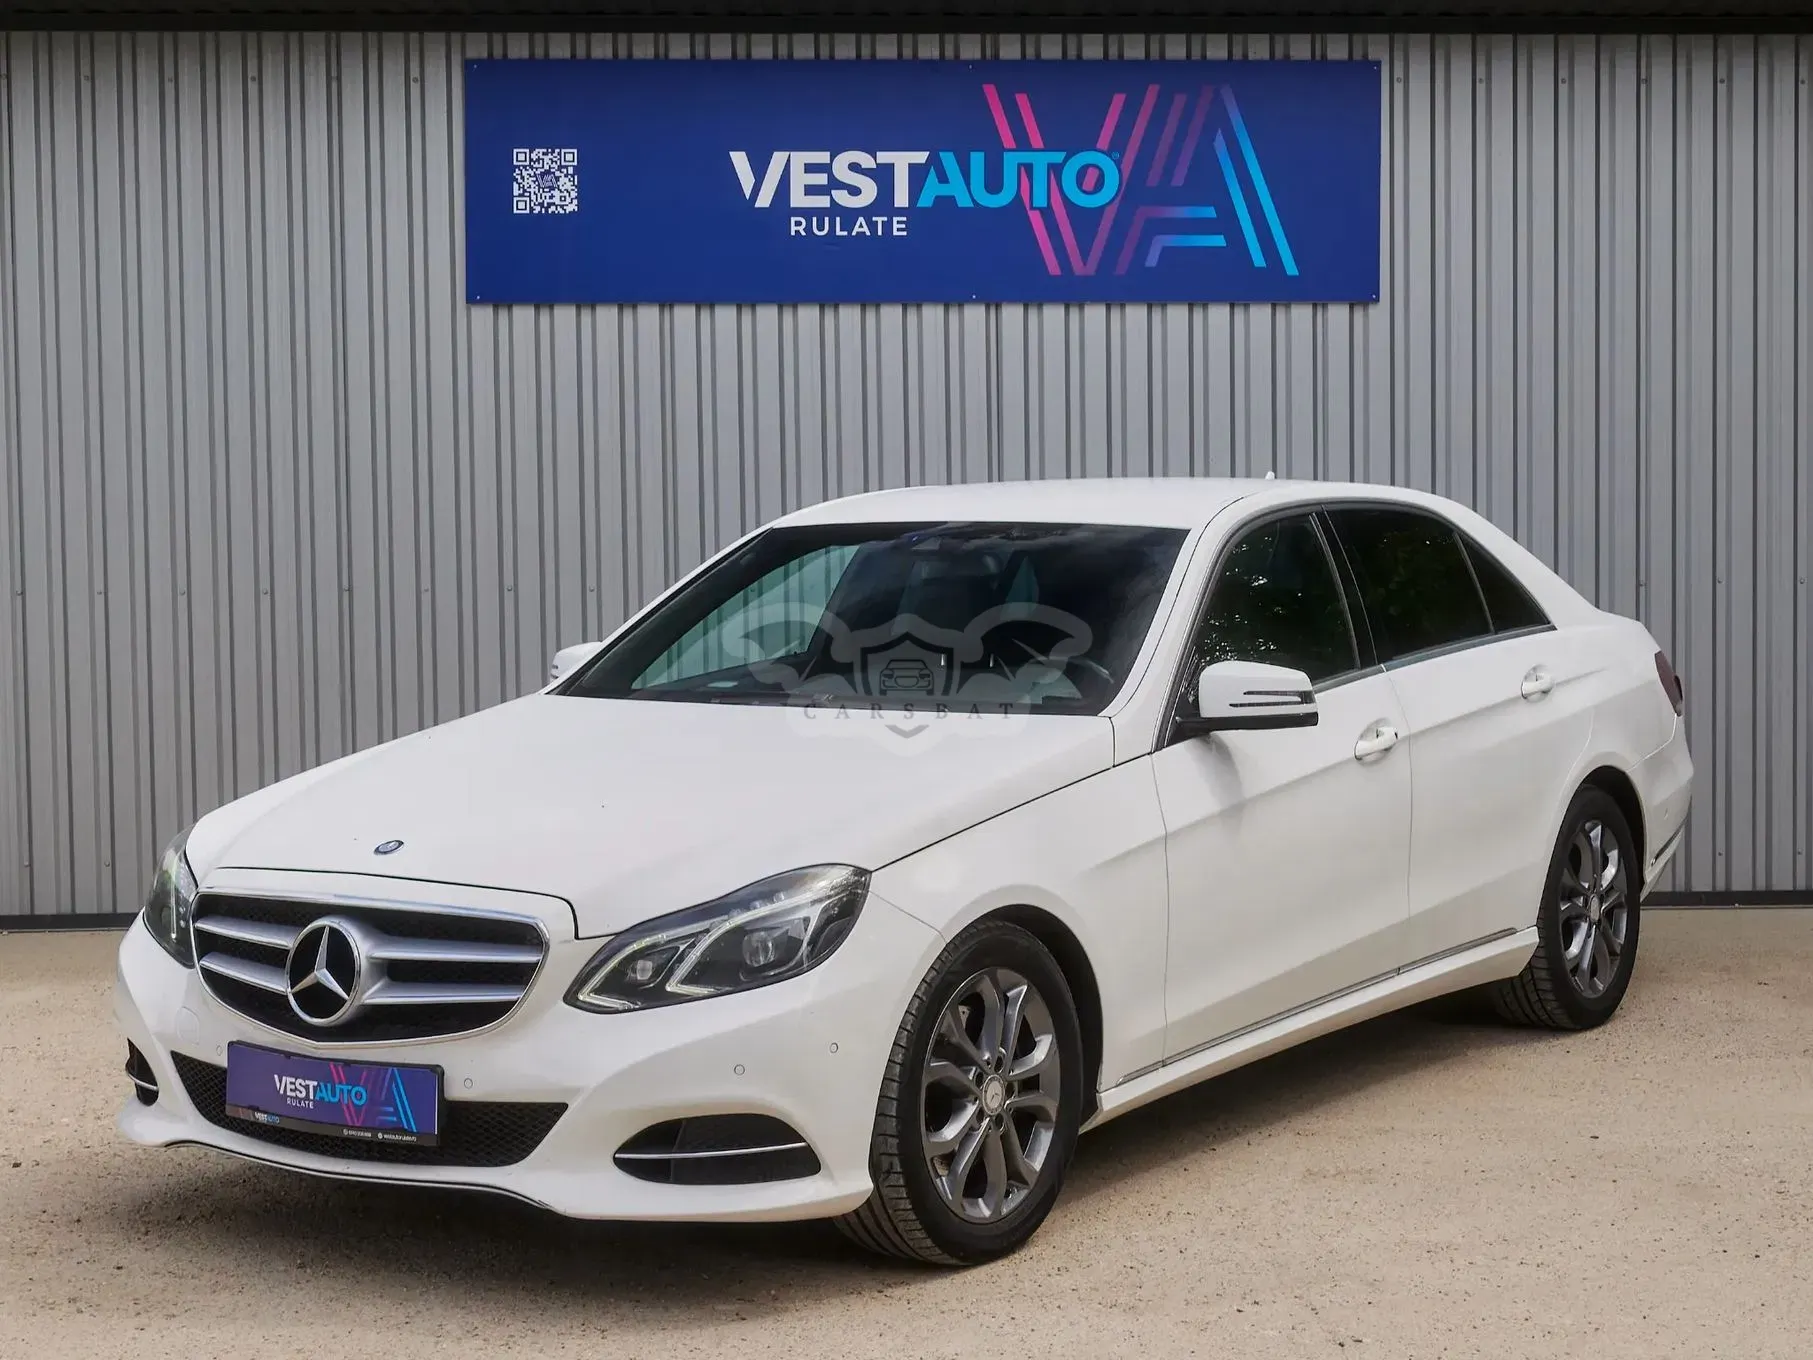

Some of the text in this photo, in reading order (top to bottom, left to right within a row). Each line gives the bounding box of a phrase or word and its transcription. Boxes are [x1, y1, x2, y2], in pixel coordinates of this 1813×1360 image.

[790, 216, 908, 237] RULATE
[274, 1074, 367, 1106] VESTAUTO
[286, 1097, 314, 1110] RULATE
